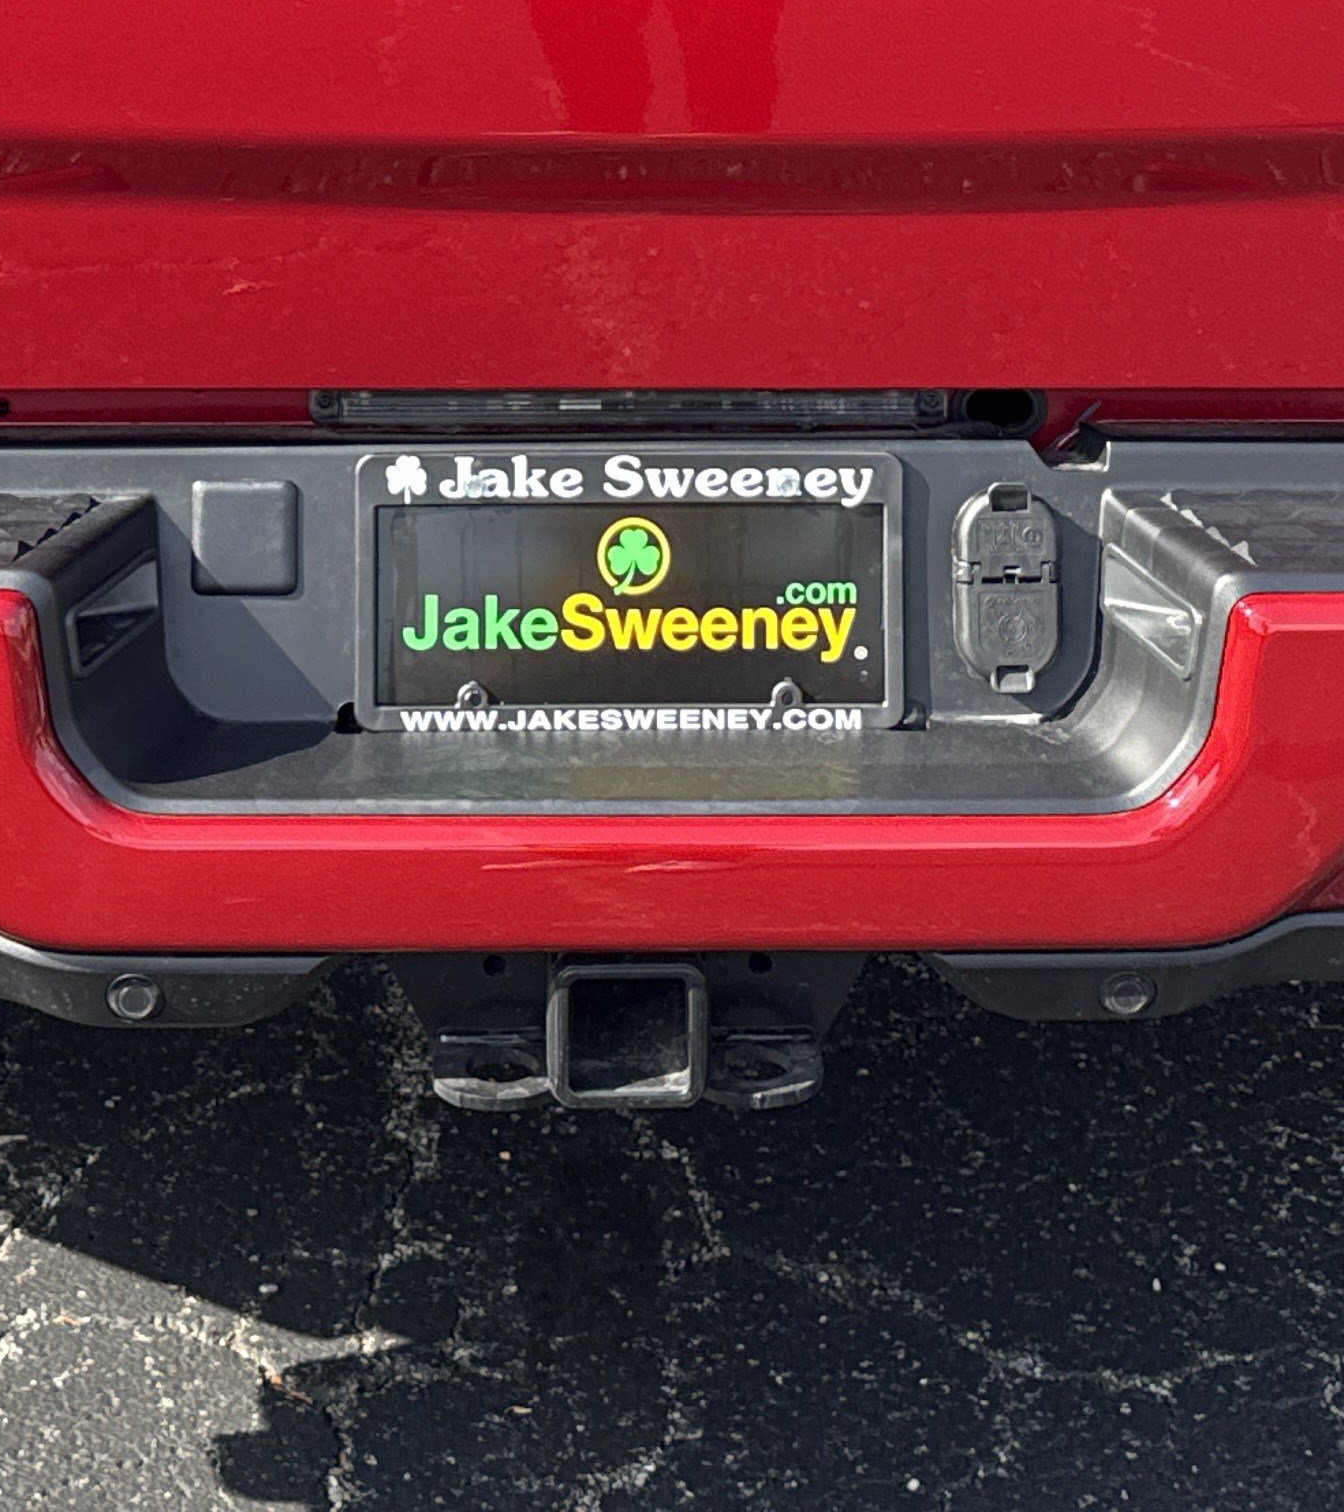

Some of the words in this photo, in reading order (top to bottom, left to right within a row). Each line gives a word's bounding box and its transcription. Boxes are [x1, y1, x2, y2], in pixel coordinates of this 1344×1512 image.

[438, 454, 584, 499] Jake
[602, 455, 874, 507] Sweeney
[776, 580, 857, 605] .com
[402, 593, 857, 662] JakeSweeney
[400, 708, 863, 732] WWW.JAKESWEENEY.COM
